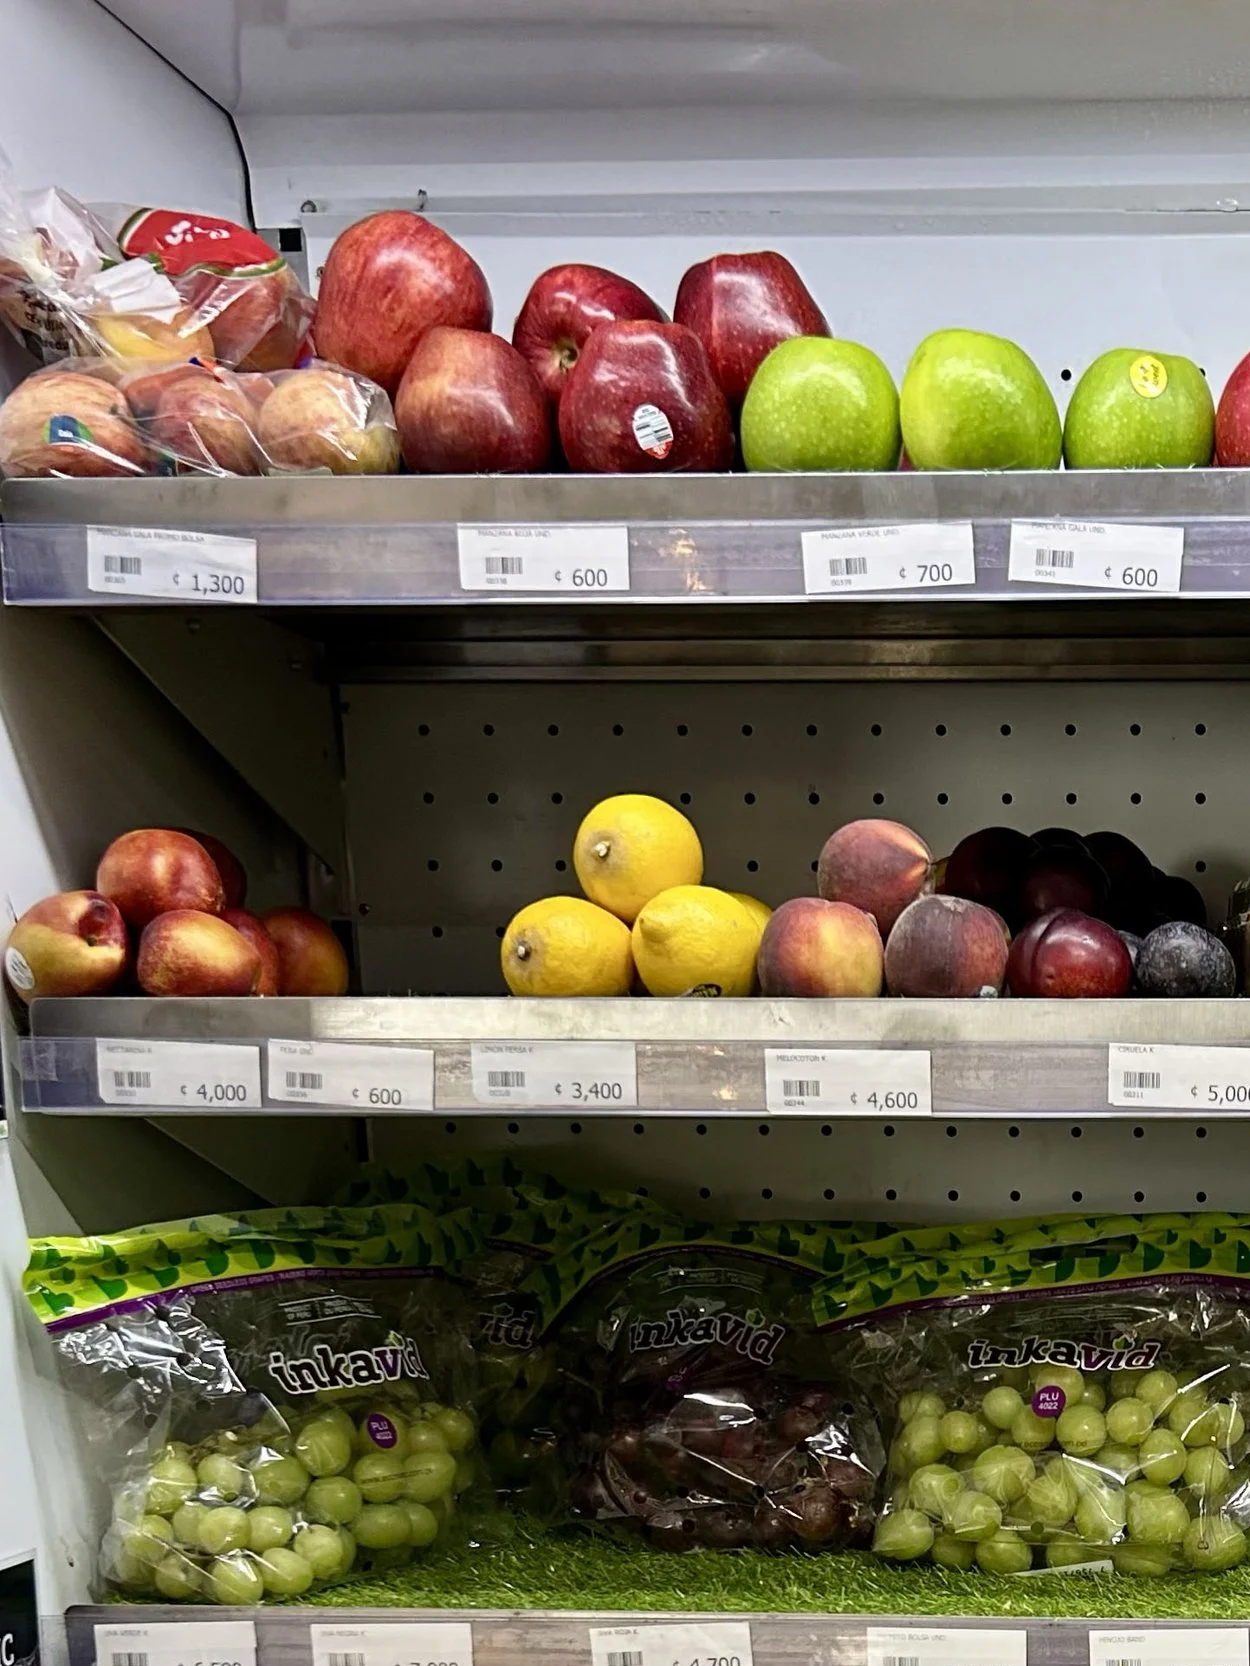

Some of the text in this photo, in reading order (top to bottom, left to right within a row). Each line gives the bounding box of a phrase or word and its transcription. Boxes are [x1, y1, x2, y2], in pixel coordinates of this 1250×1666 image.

[573, 569, 607, 586] 600
[917, 564, 952, 582] 700
[1123, 567, 1157, 587] 600
[192, 574, 244, 595] 1,300
[197, 1084, 246, 1102] 4,000
[369, 1088, 401, 1105] 600
[572, 1083, 622, 1101] 3,400
[868, 1092, 917, 1111] 4,600
[268, 1330, 430, 1394] inkavid
[968, 1336, 1160, 1371] inkavid
[1039, 1393, 1059, 1401] PLU
[1039, 1402, 1058, 1410] 4022
[371, 1421, 388, 1430] PLU
